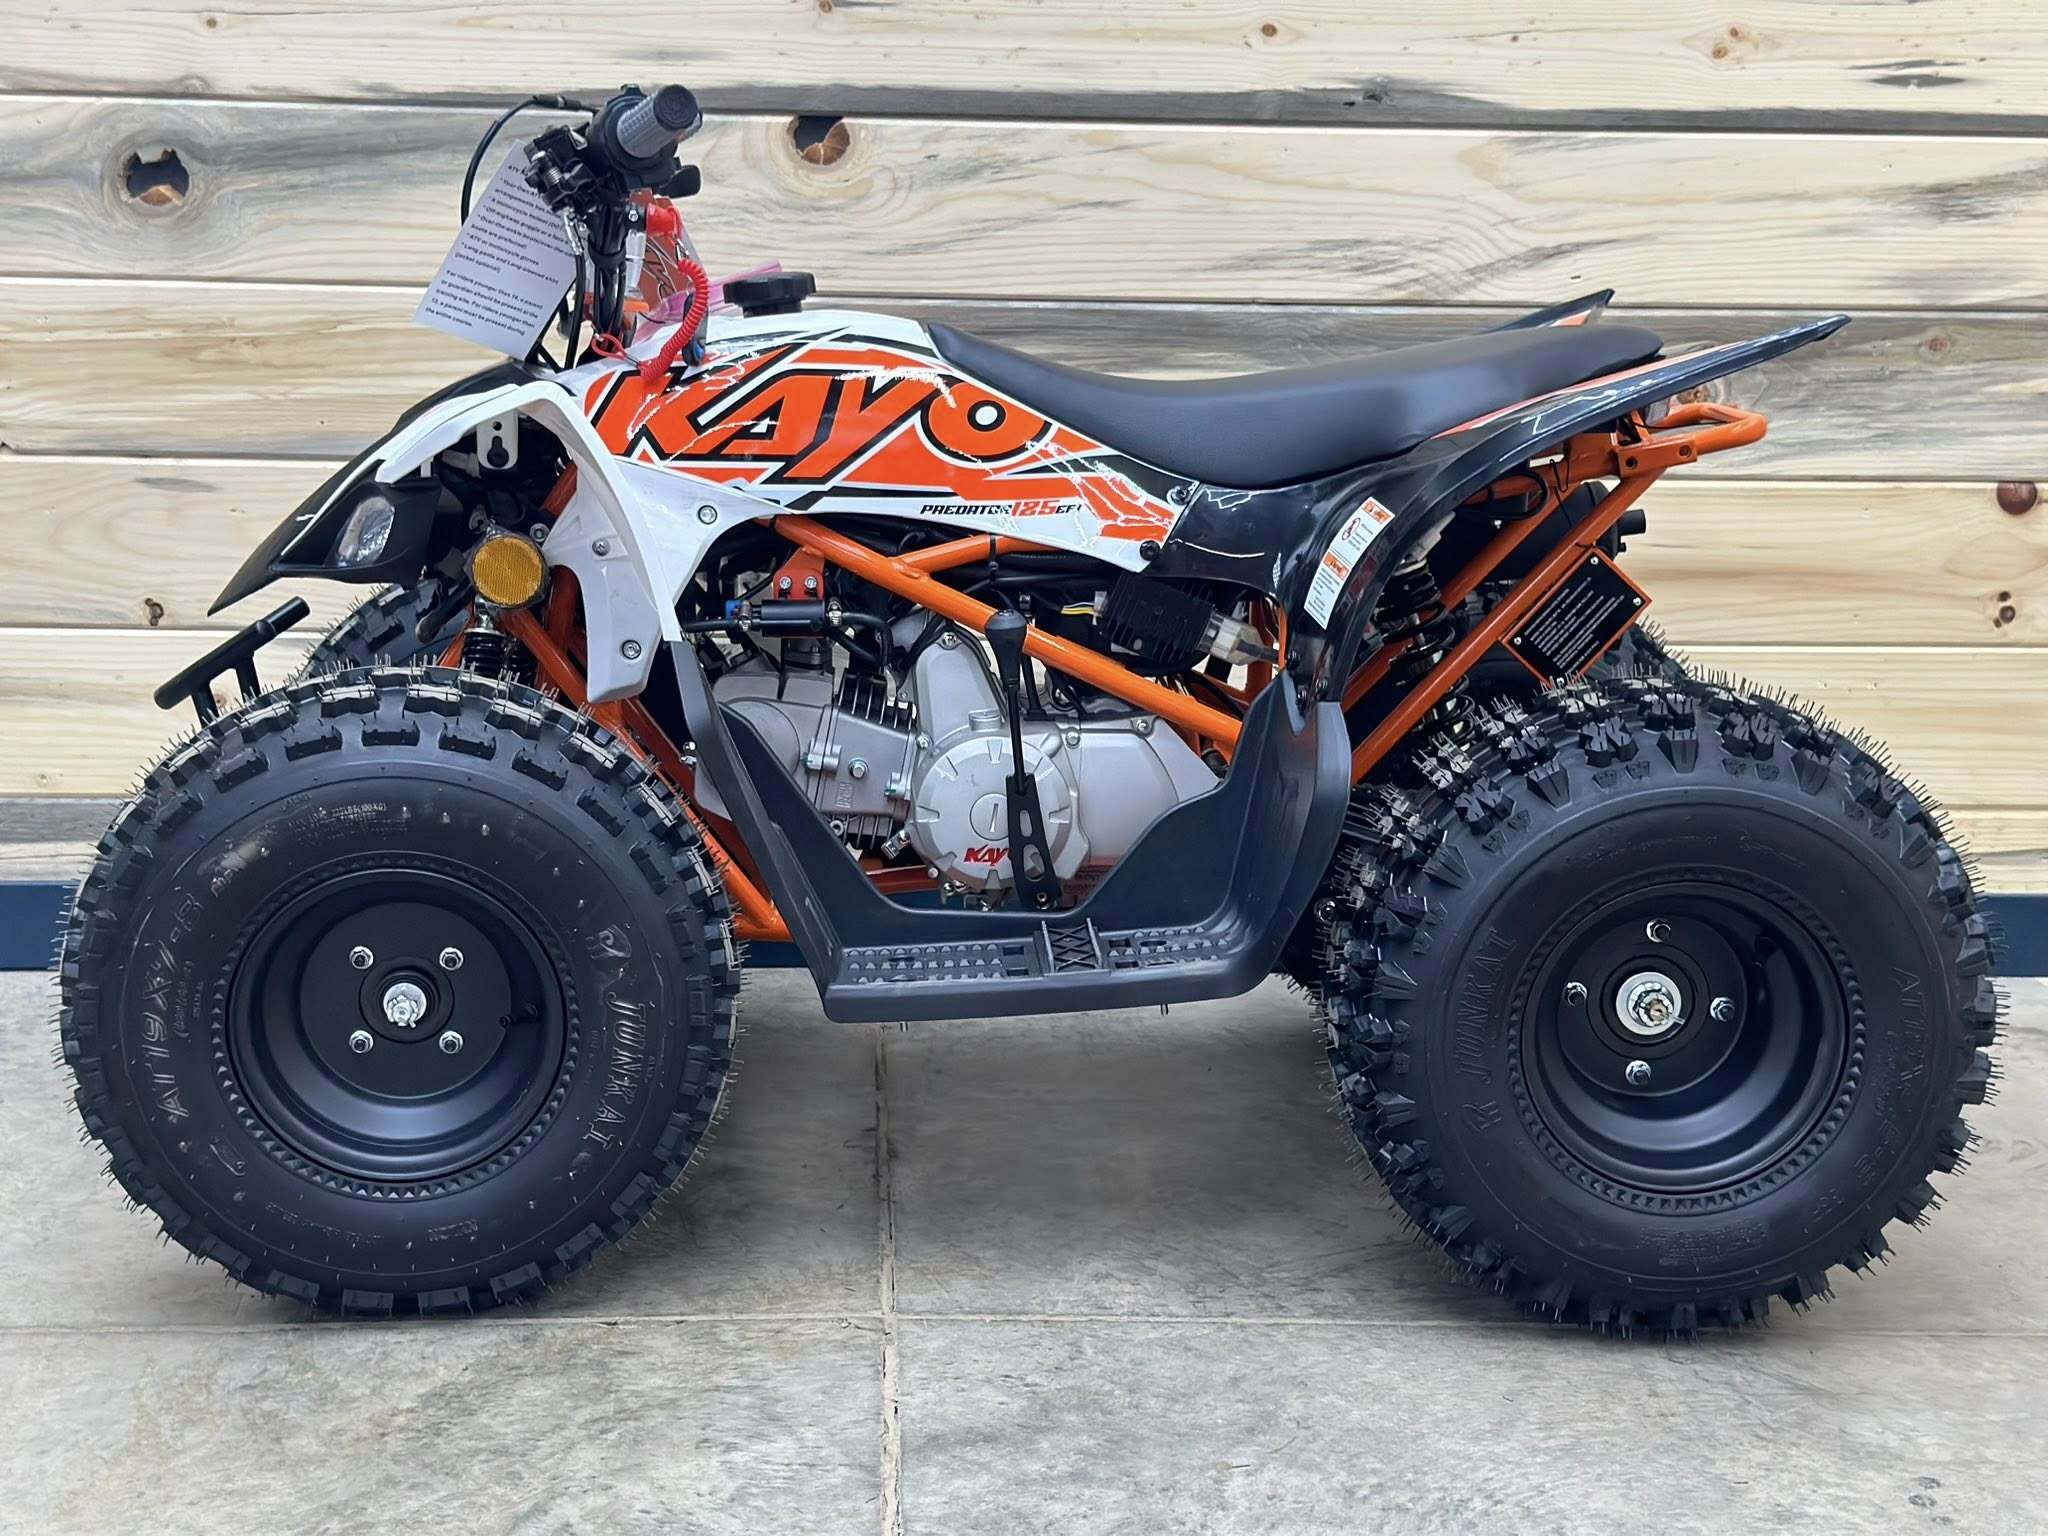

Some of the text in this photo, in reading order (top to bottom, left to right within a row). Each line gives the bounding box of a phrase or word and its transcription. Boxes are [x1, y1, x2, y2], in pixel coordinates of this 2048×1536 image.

[590, 345, 1052, 482] KAYO
[963, 843, 1013, 867] KAY
[583, 991, 646, 1150] JUNKAI
